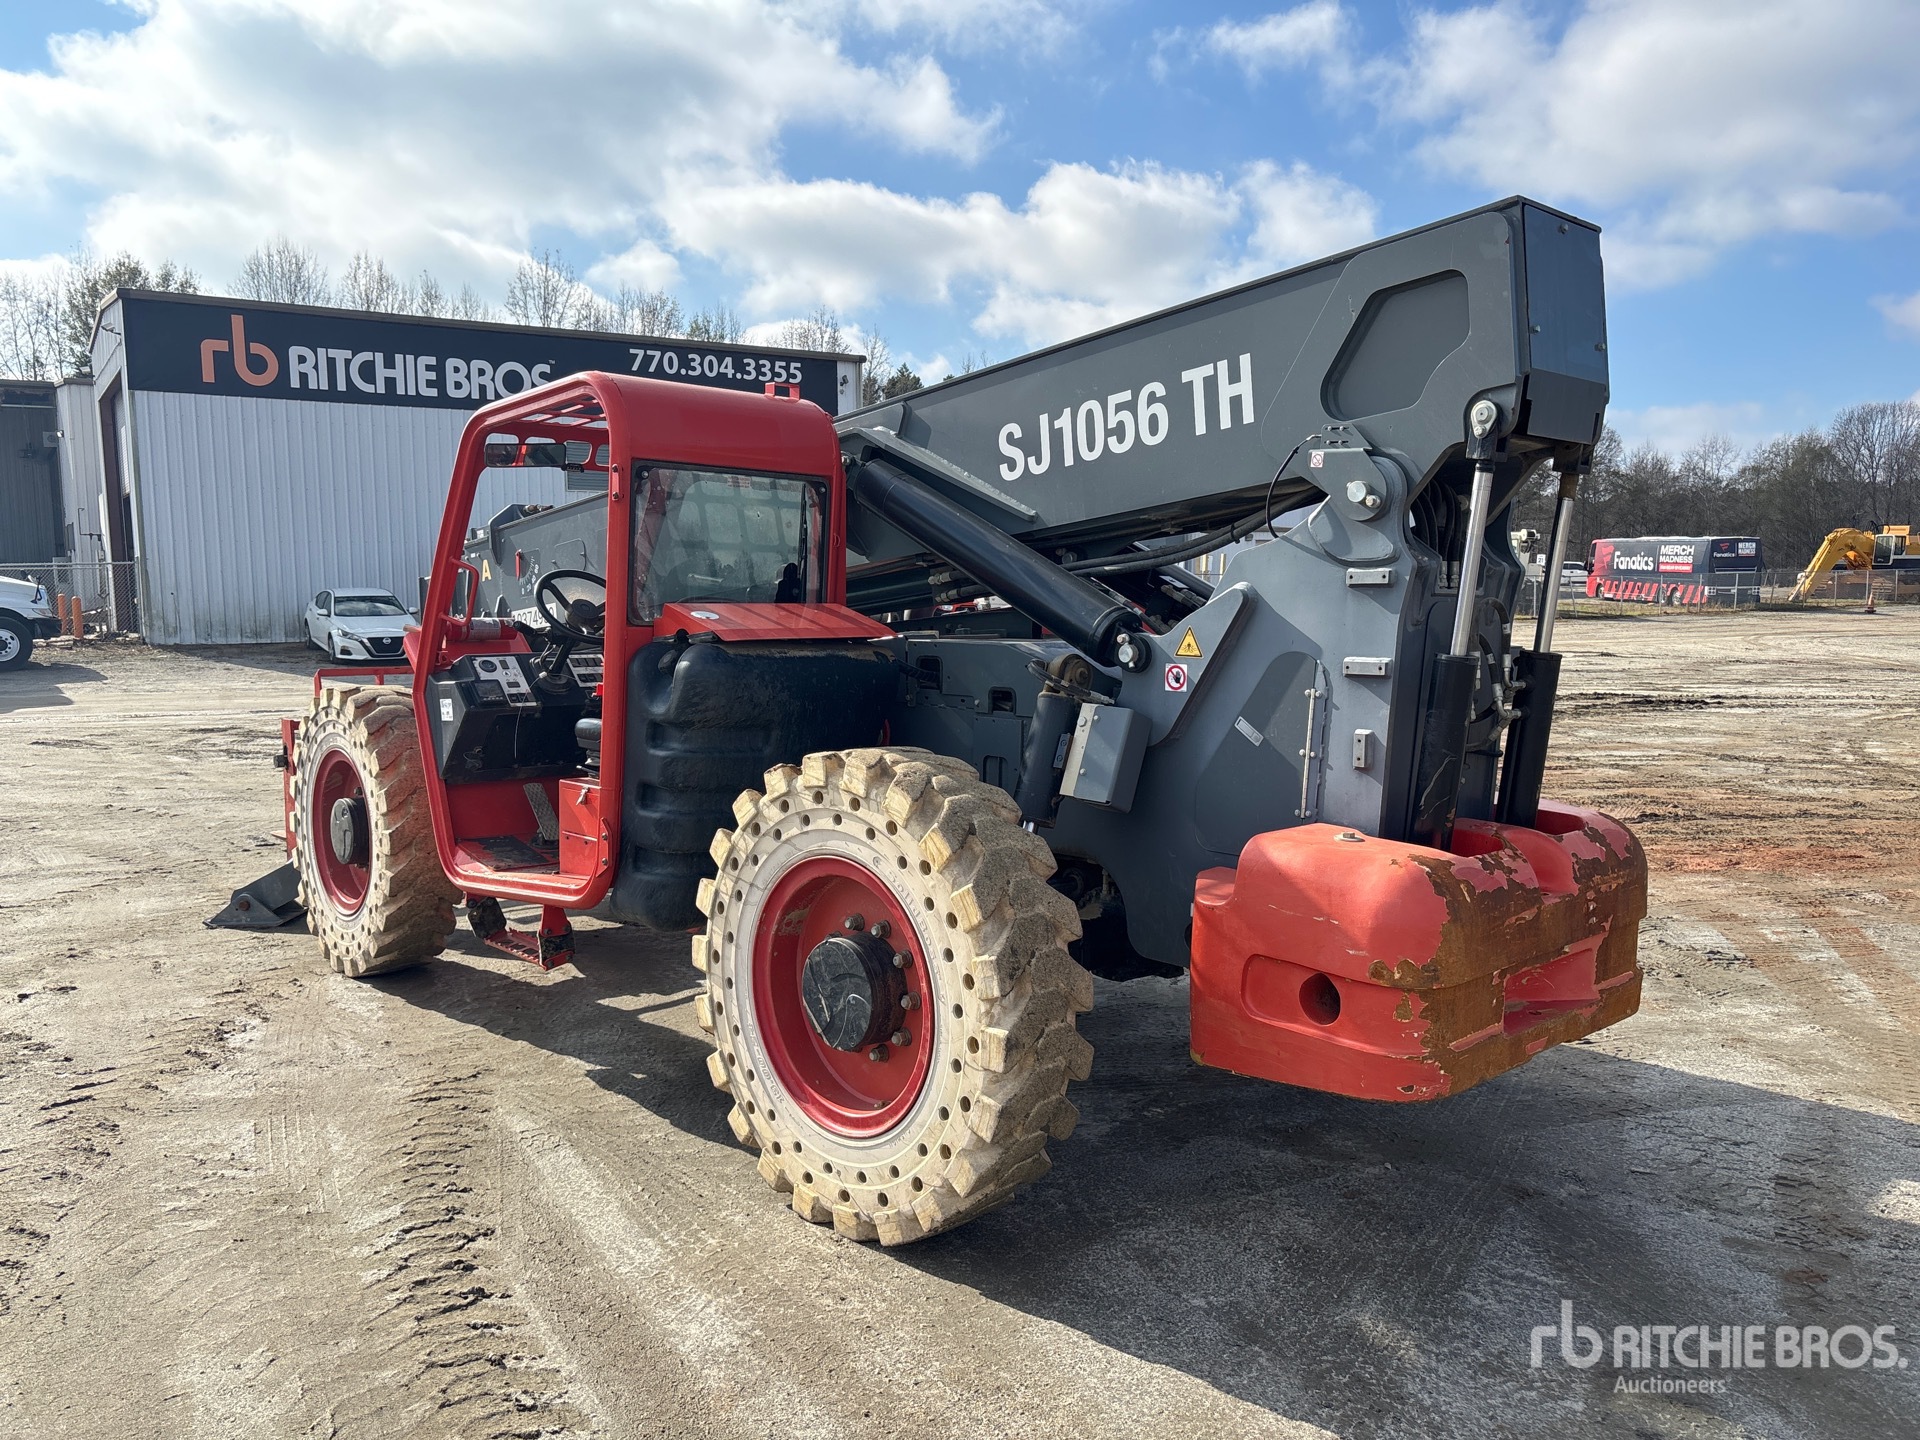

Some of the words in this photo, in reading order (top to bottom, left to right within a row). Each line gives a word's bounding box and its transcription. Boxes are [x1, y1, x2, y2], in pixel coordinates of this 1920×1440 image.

[289, 346, 439, 396] RITCHIE
[629, 349, 803, 383] 770.304.3355
[998, 381, 1169, 481] SJ1056
[1181, 352, 1255, 436] TH
[1613, 551, 1654, 571] Fanatics
[1659, 555, 1693, 563] MADNESS
[1660, 545, 1695, 555] MERCH
[482, 559, 492, 581] A
